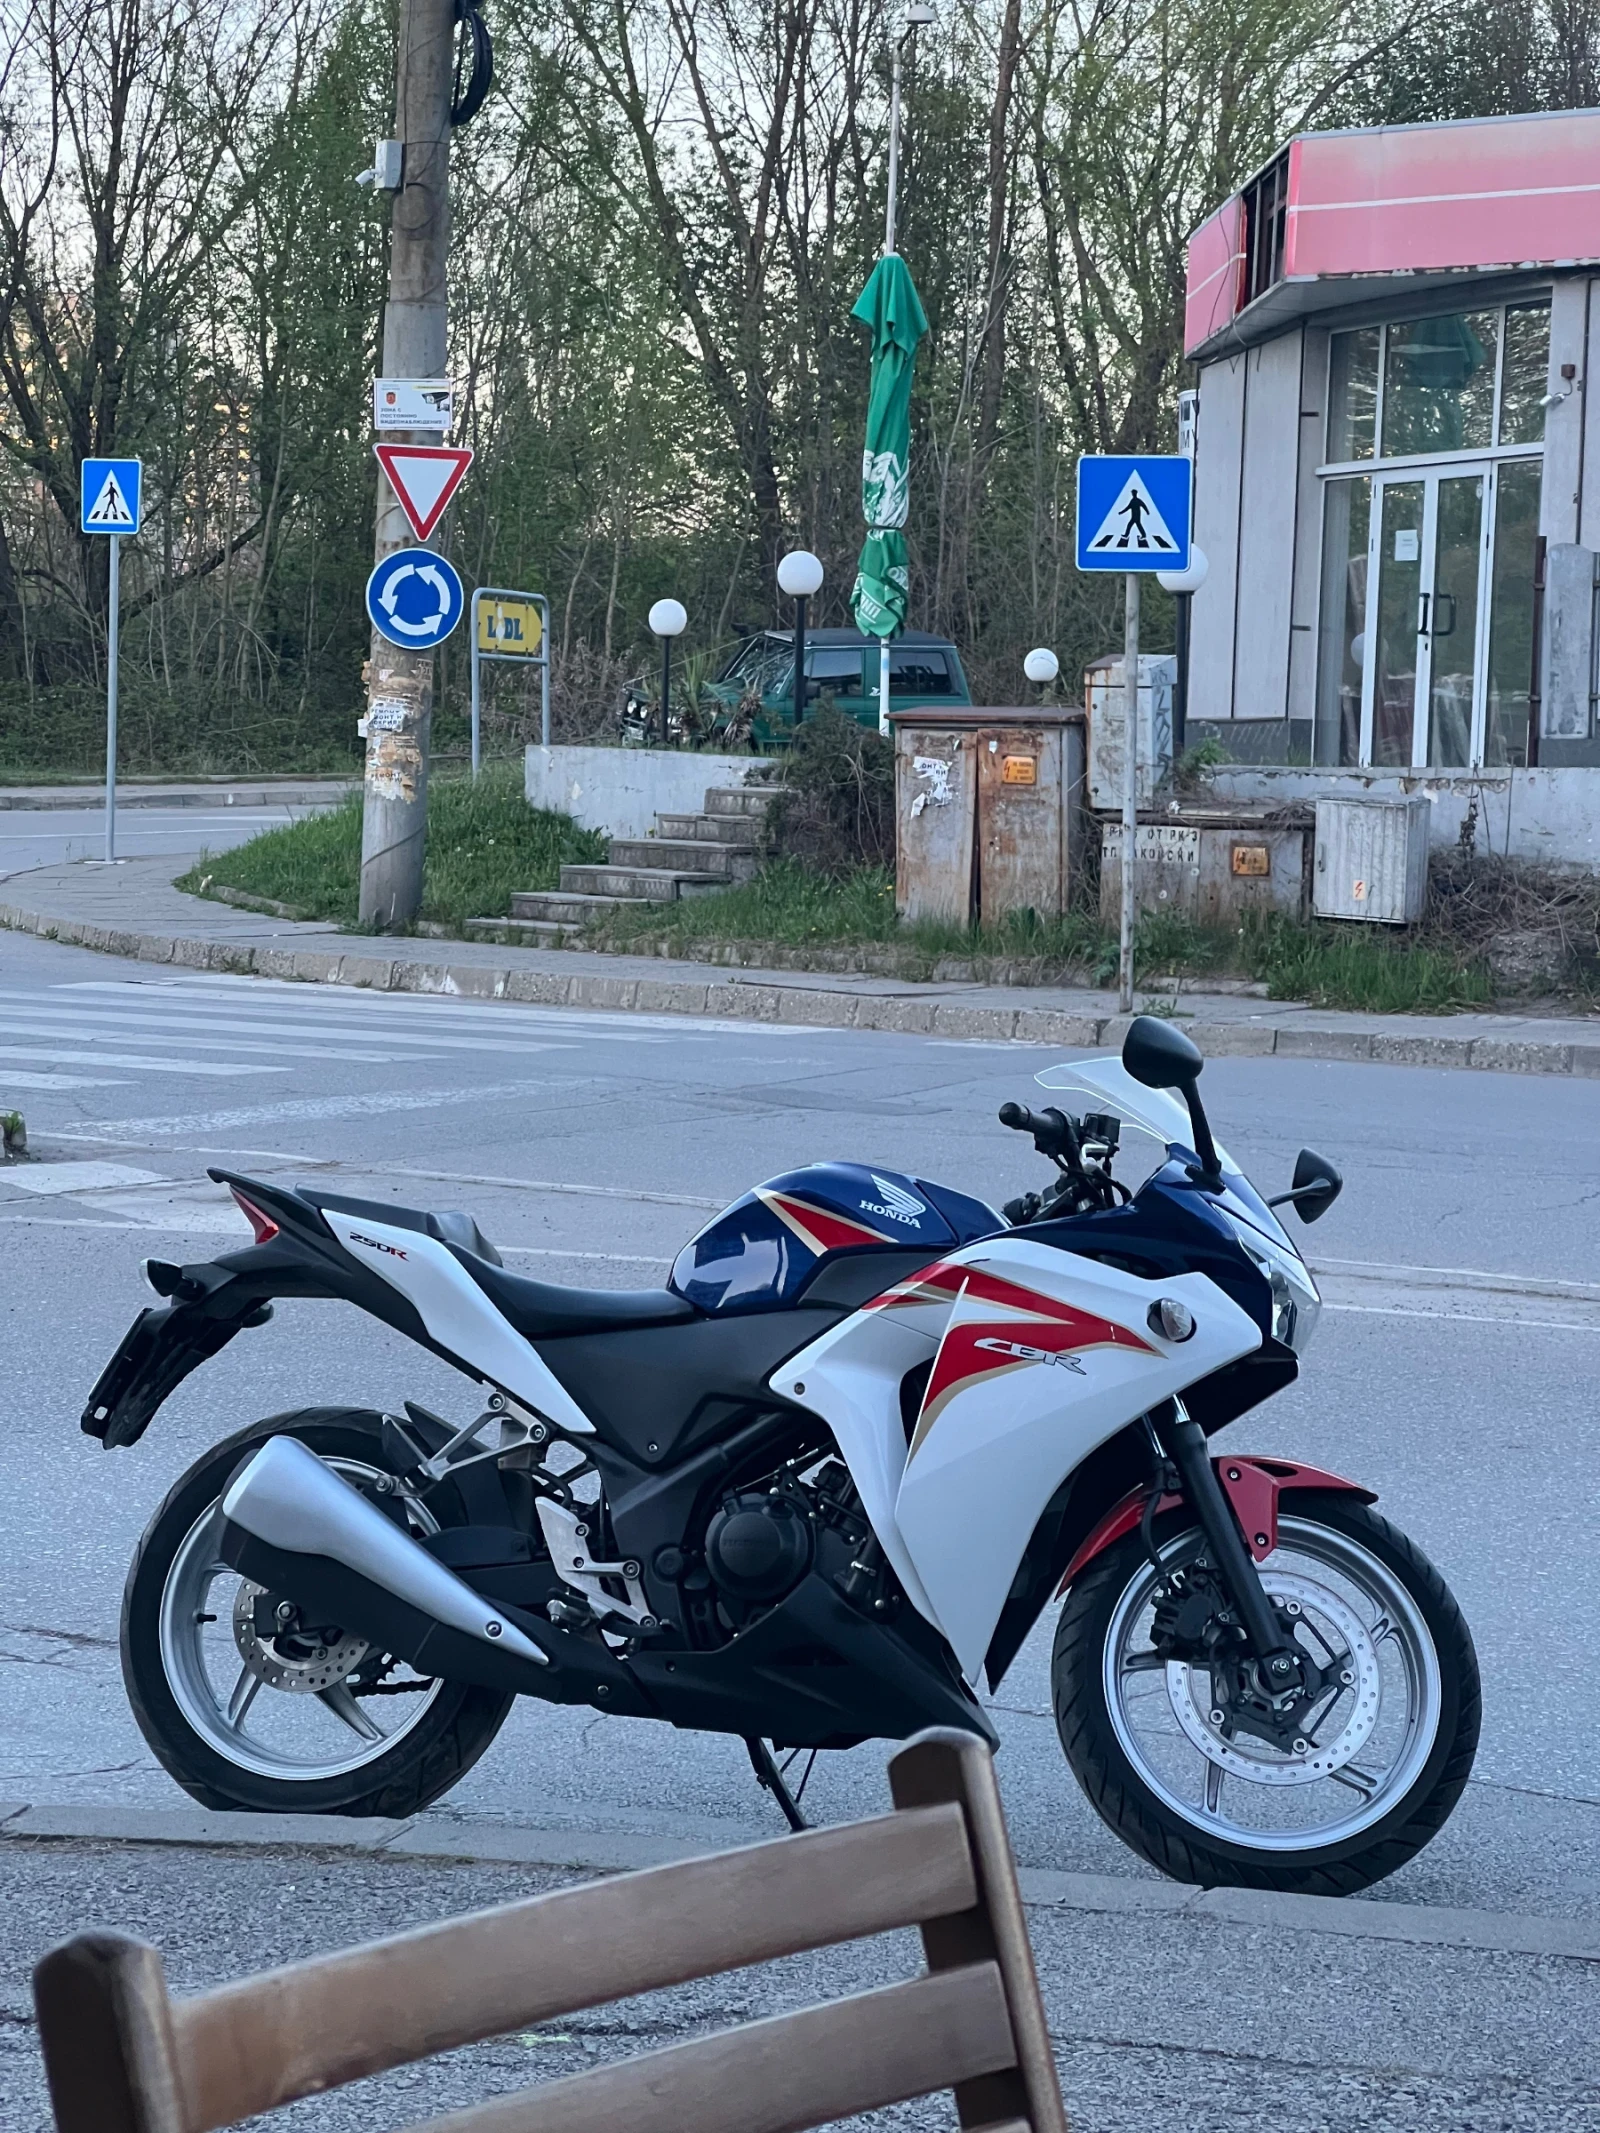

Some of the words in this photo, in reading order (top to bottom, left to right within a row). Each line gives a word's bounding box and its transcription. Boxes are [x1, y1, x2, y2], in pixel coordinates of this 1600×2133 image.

[487, 615, 523, 640] LDL
[1147, 828, 1162, 840] ОТ
[859, 1200, 921, 1229] HONDA
[350, 1231, 410, 1262] 250R
[974, 1337, 1087, 1376] CBR
